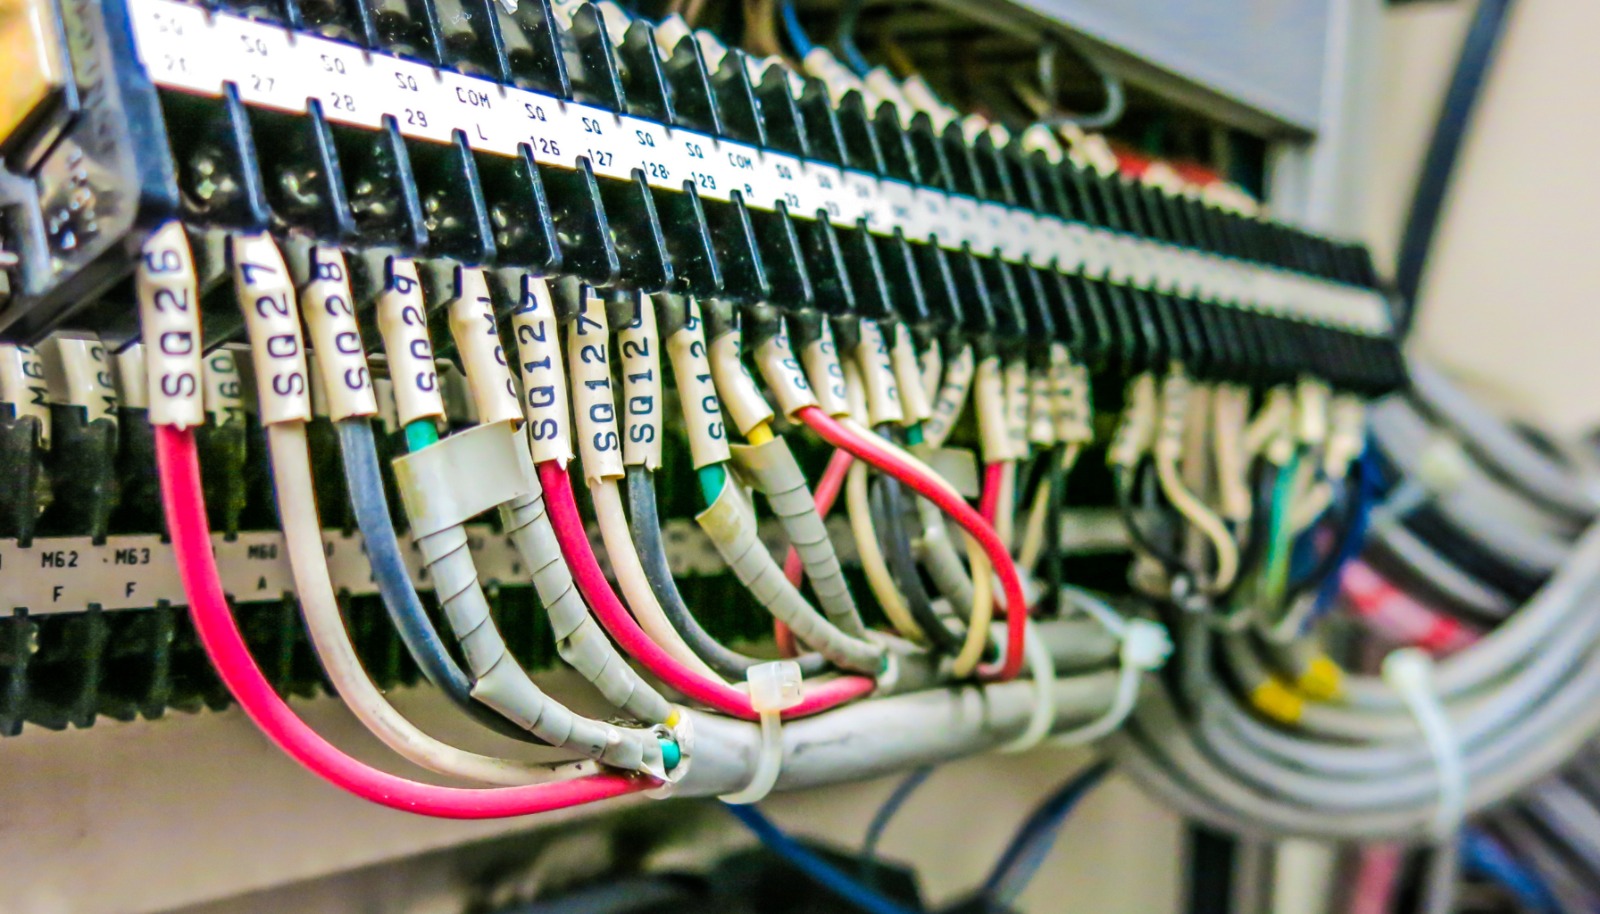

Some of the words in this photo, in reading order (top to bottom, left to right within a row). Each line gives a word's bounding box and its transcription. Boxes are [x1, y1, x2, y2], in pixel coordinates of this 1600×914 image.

[320, 53, 346, 75] SQ
[251, 73, 275, 92] 27
[394, 72, 420, 92] SQ
[330, 92, 356, 112] 28
[455, 86, 491, 110] COM
[405, 107, 429, 128] 29
[525, 102, 548, 122] SQ
[476, 123, 489, 141] L
[582, 116, 603, 135] SQ
[530, 135, 561, 157] 126
[636, 129, 656, 148] SQ
[587, 148, 614, 168] 127
[685, 141, 705, 160] SQ
[642, 160, 668, 180] 128
[728, 151, 754, 172] COM
[691, 171, 717, 191] 129
[745, 183, 754, 199] R
[784, 192, 801, 208] 32
[145, 249, 197, 398] SQ26
[239, 261, 305, 397] SQ27
[316, 261, 371, 390] SQ28
[394, 273, 439, 392] SQ29
[514, 291, 558, 441] SQ126
[577, 313, 618, 452] SQ127
[41, 550, 78, 568] M62
[115, 548, 150, 566] M63
[53, 585, 64, 602] F
[126, 582, 137, 598] F
